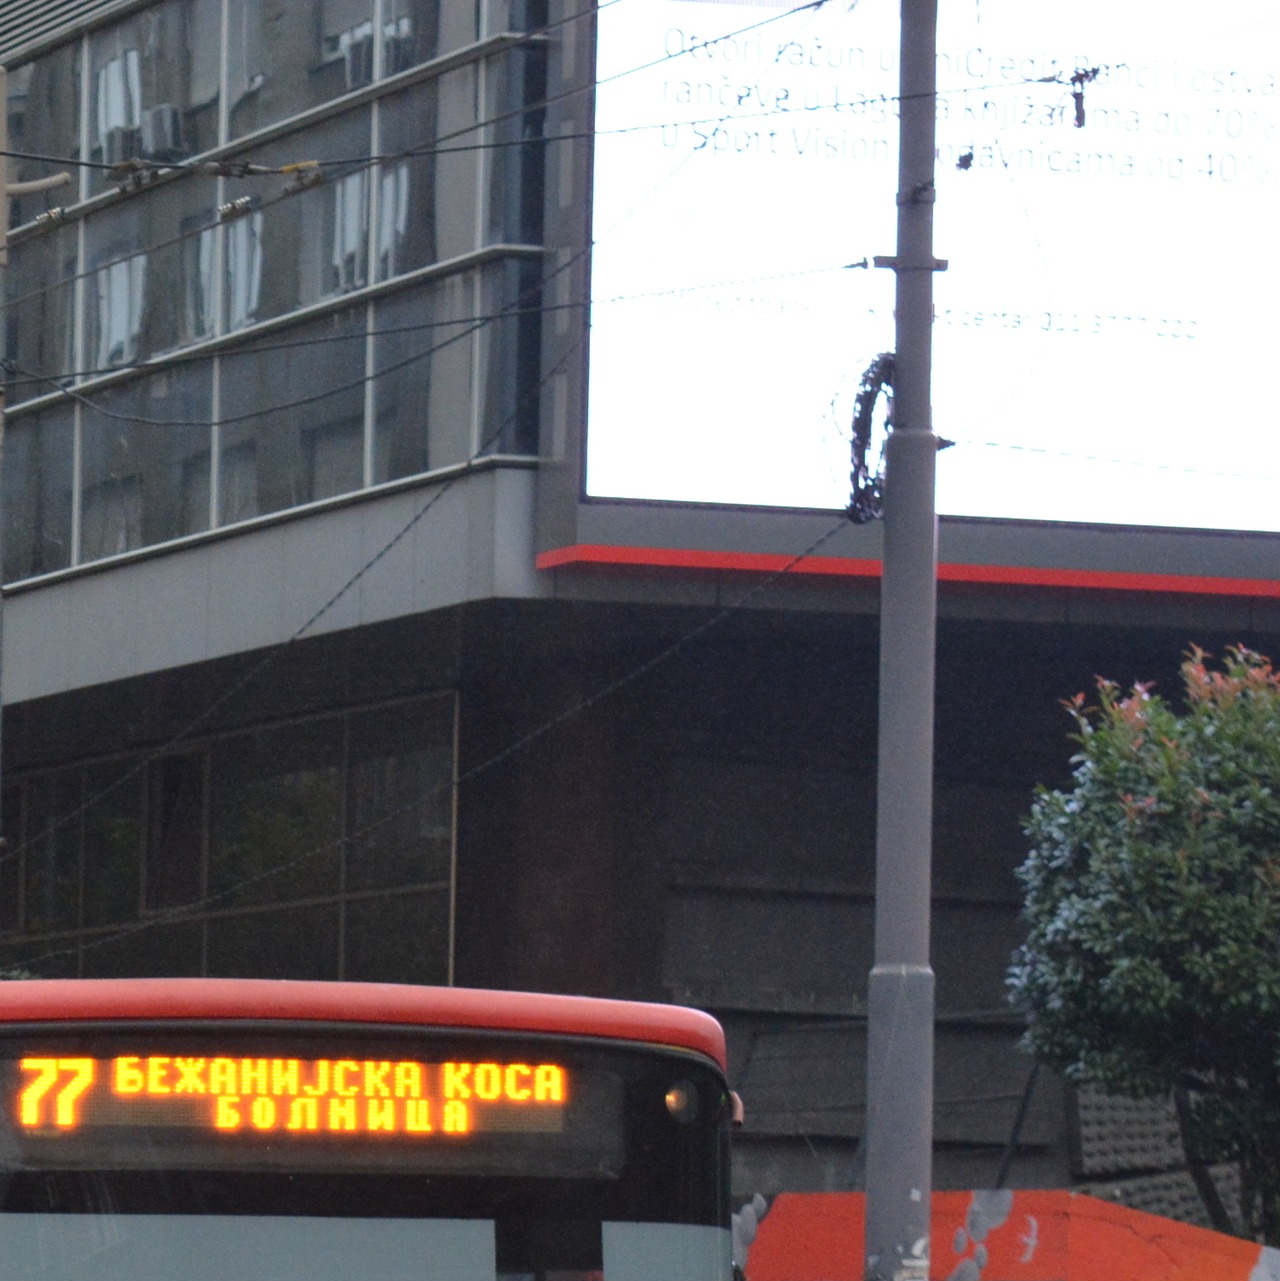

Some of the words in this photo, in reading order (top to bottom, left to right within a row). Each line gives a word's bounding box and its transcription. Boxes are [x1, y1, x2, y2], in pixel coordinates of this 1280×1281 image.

[936, 47, 1063, 82] niCredit
[835, 85, 949, 124] Laga
[936, 139, 1137, 177] odavnicama
[20, 1057, 95, 1127] 77
[114, 1057, 422, 1098] БЕЖАНИЈСКА
[443, 1062, 562, 1101] КОСА
[215, 1097, 469, 1133] БОЛНИЦА
